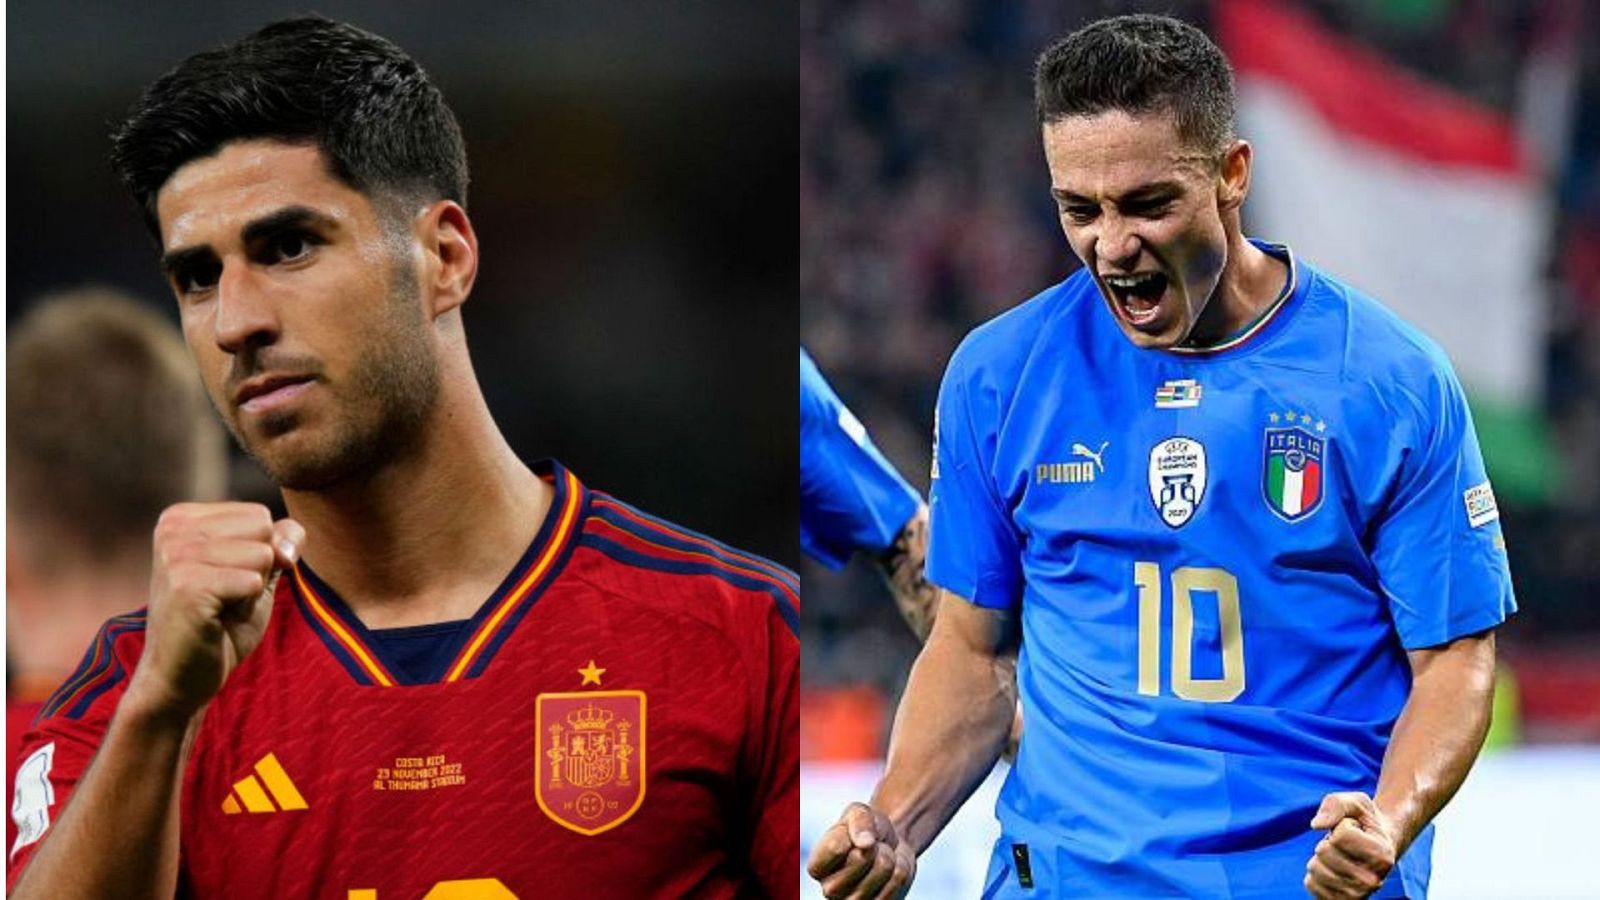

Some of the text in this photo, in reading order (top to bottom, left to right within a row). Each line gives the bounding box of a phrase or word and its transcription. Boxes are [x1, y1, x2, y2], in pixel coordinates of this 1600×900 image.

[1269, 434, 1321, 455] ITALIA
[1036, 462, 1096, 483] PUMA
[1134, 561, 1246, 702] 10
[395, 754, 445, 768] COSTA RICA
[376, 763, 462, 779] 23 NOVEMBER 2022
[373, 775, 466, 790] AL THUMAMA STADIUM
